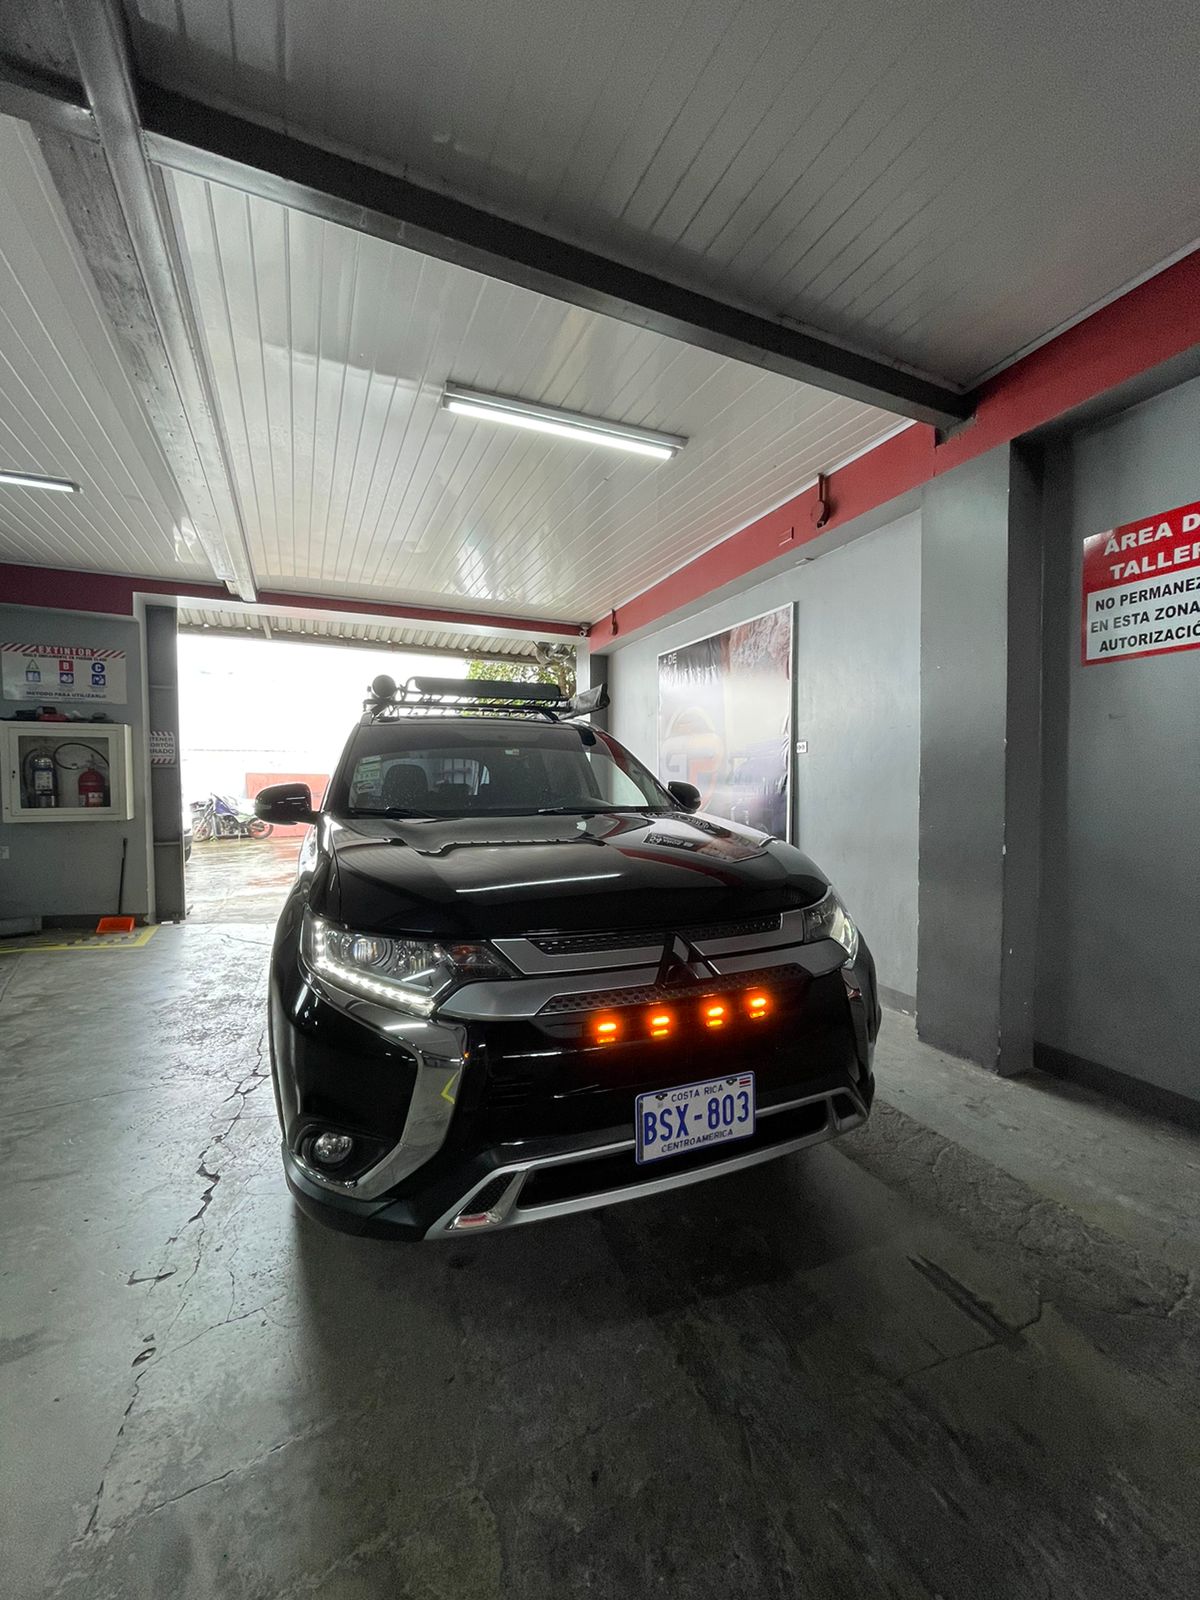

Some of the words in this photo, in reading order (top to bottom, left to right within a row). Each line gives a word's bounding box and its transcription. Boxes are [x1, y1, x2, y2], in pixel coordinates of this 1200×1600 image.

[1103, 521, 1174, 556] ÁREA
[1095, 598, 1116, 613] NO
[1090, 618, 1109, 634] EN
[1113, 610, 1150, 630] ESTA
[1154, 600, 1200, 621] ZONA
[38, 645, 93, 657] EXTINTOR
[62, 662, 70, 670] B
[94, 663, 102, 672] C
[671, 1088, 701, 1103] COSTA
[703, 1083, 724, 1096] RICA
[643, 1090, 750, 1146] BSX-803
[661, 1127, 734, 1153] CENTROAMERICA
